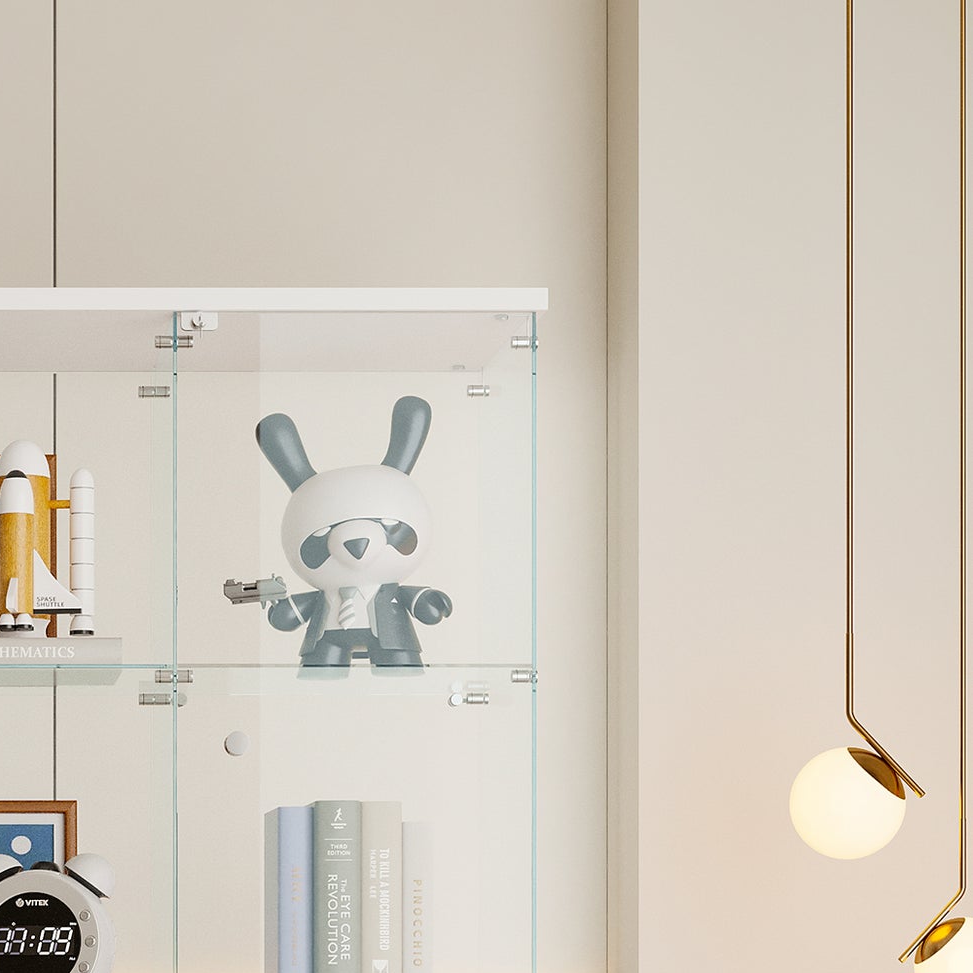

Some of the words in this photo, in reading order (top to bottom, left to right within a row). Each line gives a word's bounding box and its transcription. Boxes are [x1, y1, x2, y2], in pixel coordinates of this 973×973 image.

[380, 848, 390, 859] TO
[380, 862, 390, 880] KILL
[380, 881, 390, 889] A
[341, 895, 351, 919] EYE
[327, 874, 338, 965] REVOLUTION
[413, 879, 422, 967] PINOCCHIO
[341, 924, 351, 960] CARE
